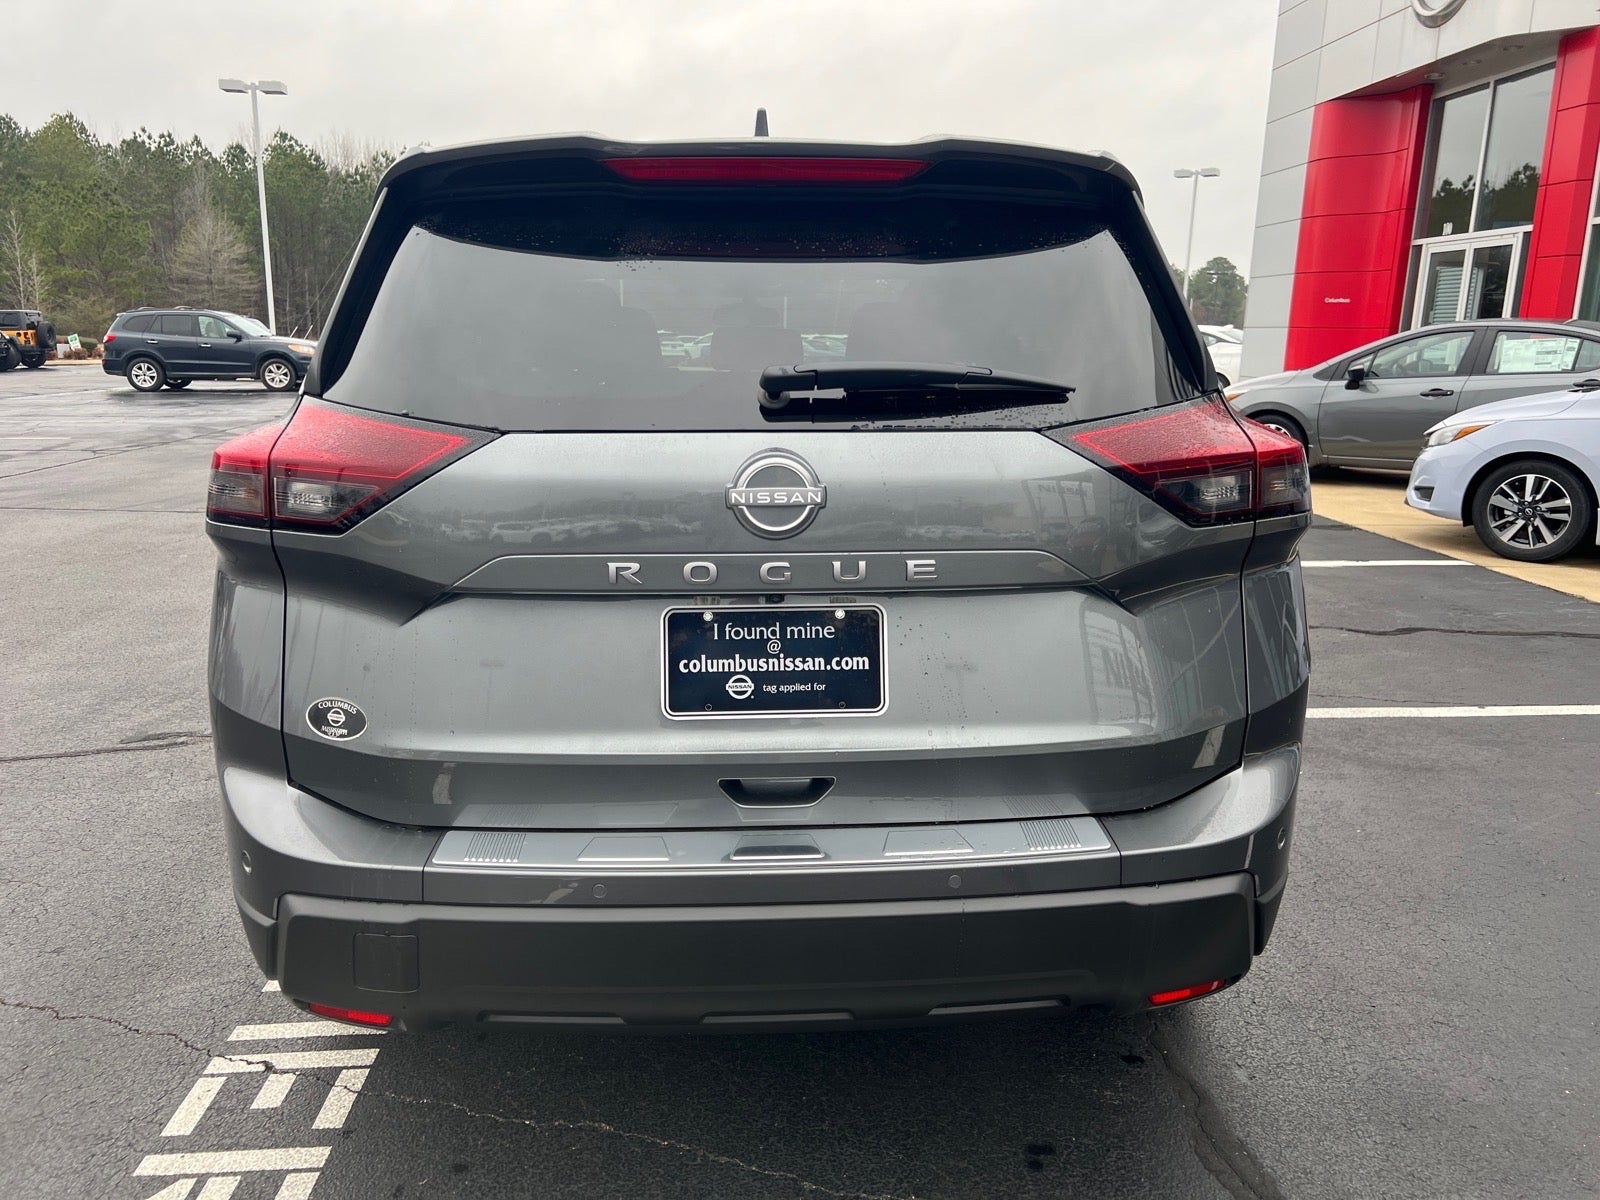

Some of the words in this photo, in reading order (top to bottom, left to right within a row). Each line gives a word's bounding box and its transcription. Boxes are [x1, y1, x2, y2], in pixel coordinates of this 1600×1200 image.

[731, 491, 822, 503] NISSAN
[607, 559, 938, 585] ROGUE
[713, 623, 719, 640] I
[725, 622, 780, 640] found
[786, 623, 835, 639] mine
[767, 640, 782, 654] @
[678, 653, 870, 673] columbusnissan.com
[763, 683, 777, 693] tag
[779, 682, 811, 693] applied
[813, 682, 826, 691] for
[318, 700, 358, 715] COLUMBUS
